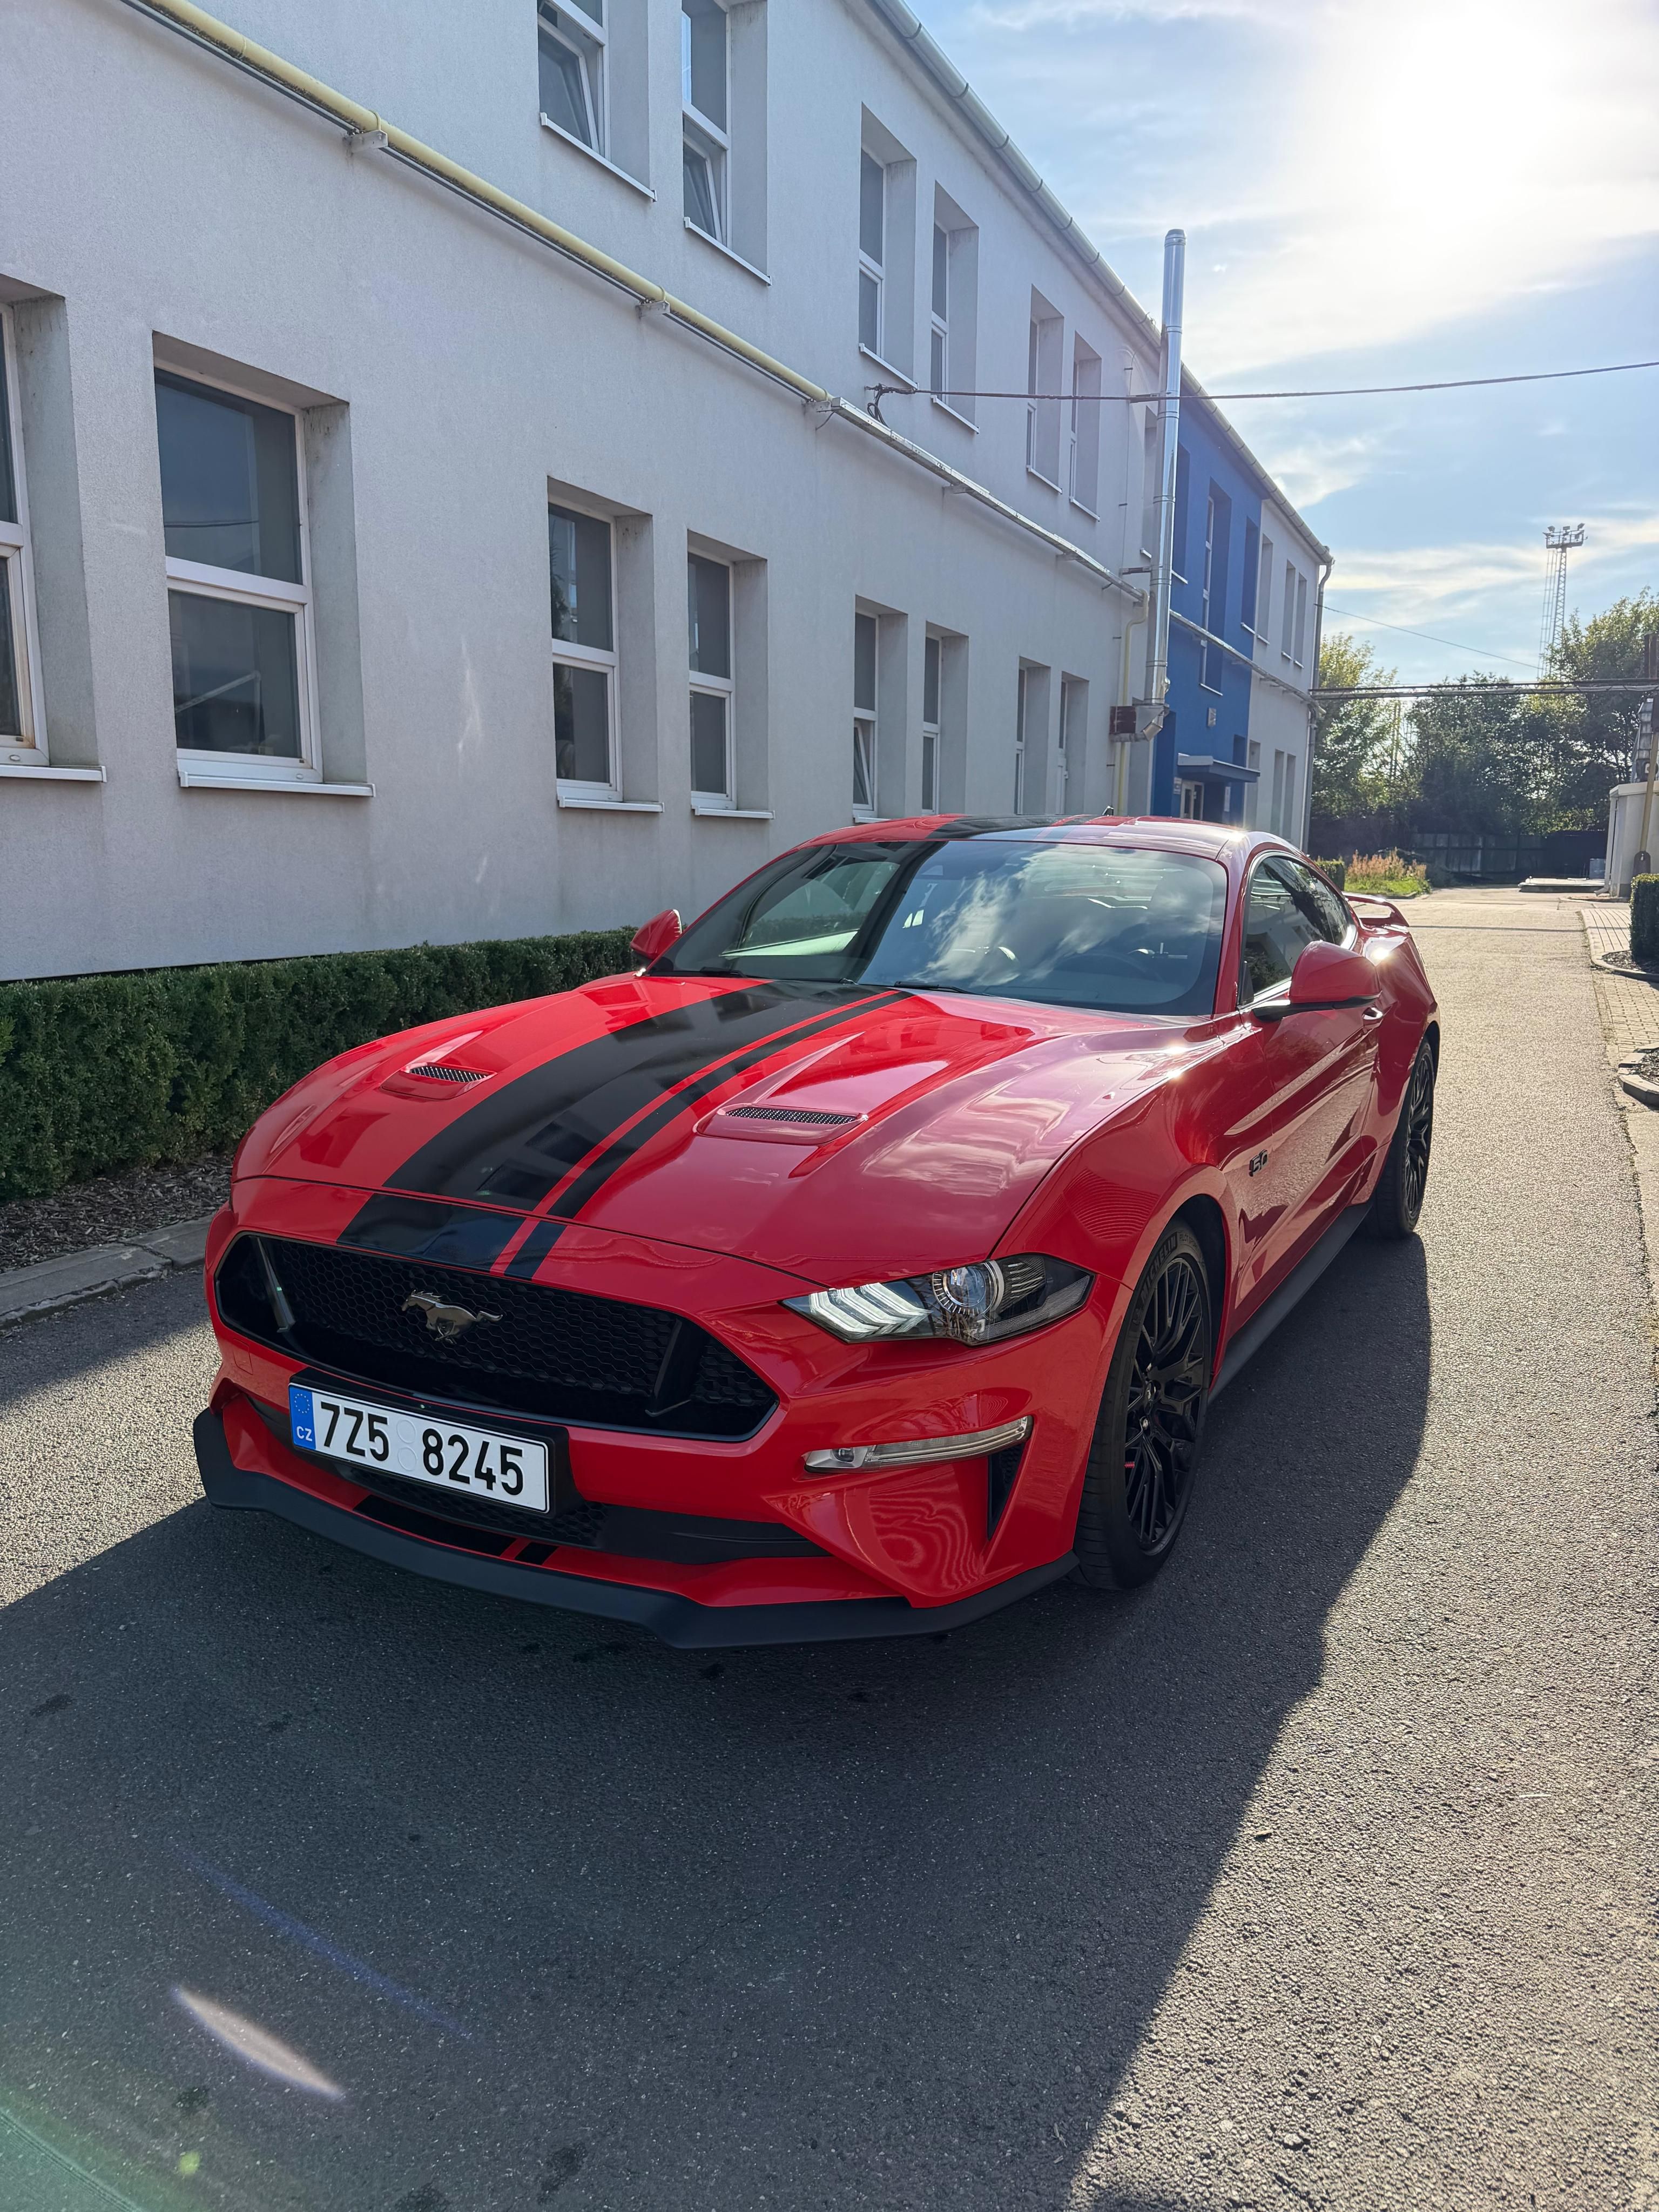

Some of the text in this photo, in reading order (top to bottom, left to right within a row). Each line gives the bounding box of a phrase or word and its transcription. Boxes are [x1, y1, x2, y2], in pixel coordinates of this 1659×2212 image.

[1141, 1235, 1176, 1304] MICHELIN
[296, 1425, 313, 1442] CZ
[321, 1401, 524, 1495] 7Z5 8245
